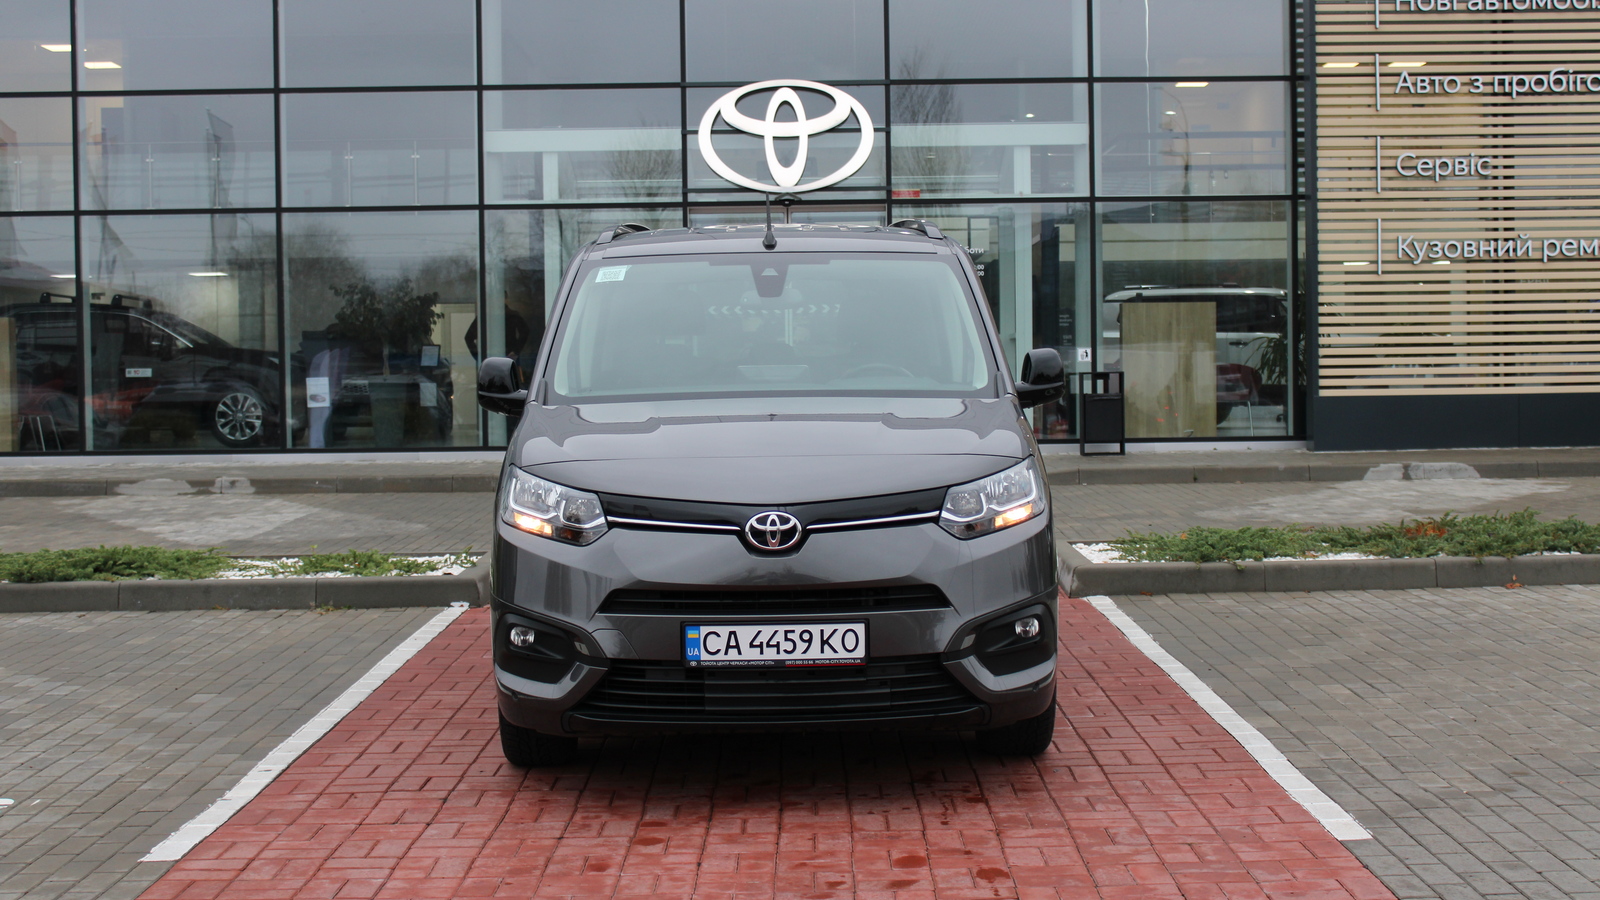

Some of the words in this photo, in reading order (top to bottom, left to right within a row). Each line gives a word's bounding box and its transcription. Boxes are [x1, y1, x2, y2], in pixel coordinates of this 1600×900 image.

[1394, 70, 1461, 94] Авто
[1469, 75, 1484, 94] з
[1493, 67, 1600, 99] пробіго
[1396, 152, 1491, 182] Сервіс
[1397, 234, 1532, 265] Кузовний
[1542, 238, 1600, 263] рем
[687, 648, 700, 656] UA
[702, 631, 742, 656] CA
[749, 629, 813, 655] 4459
